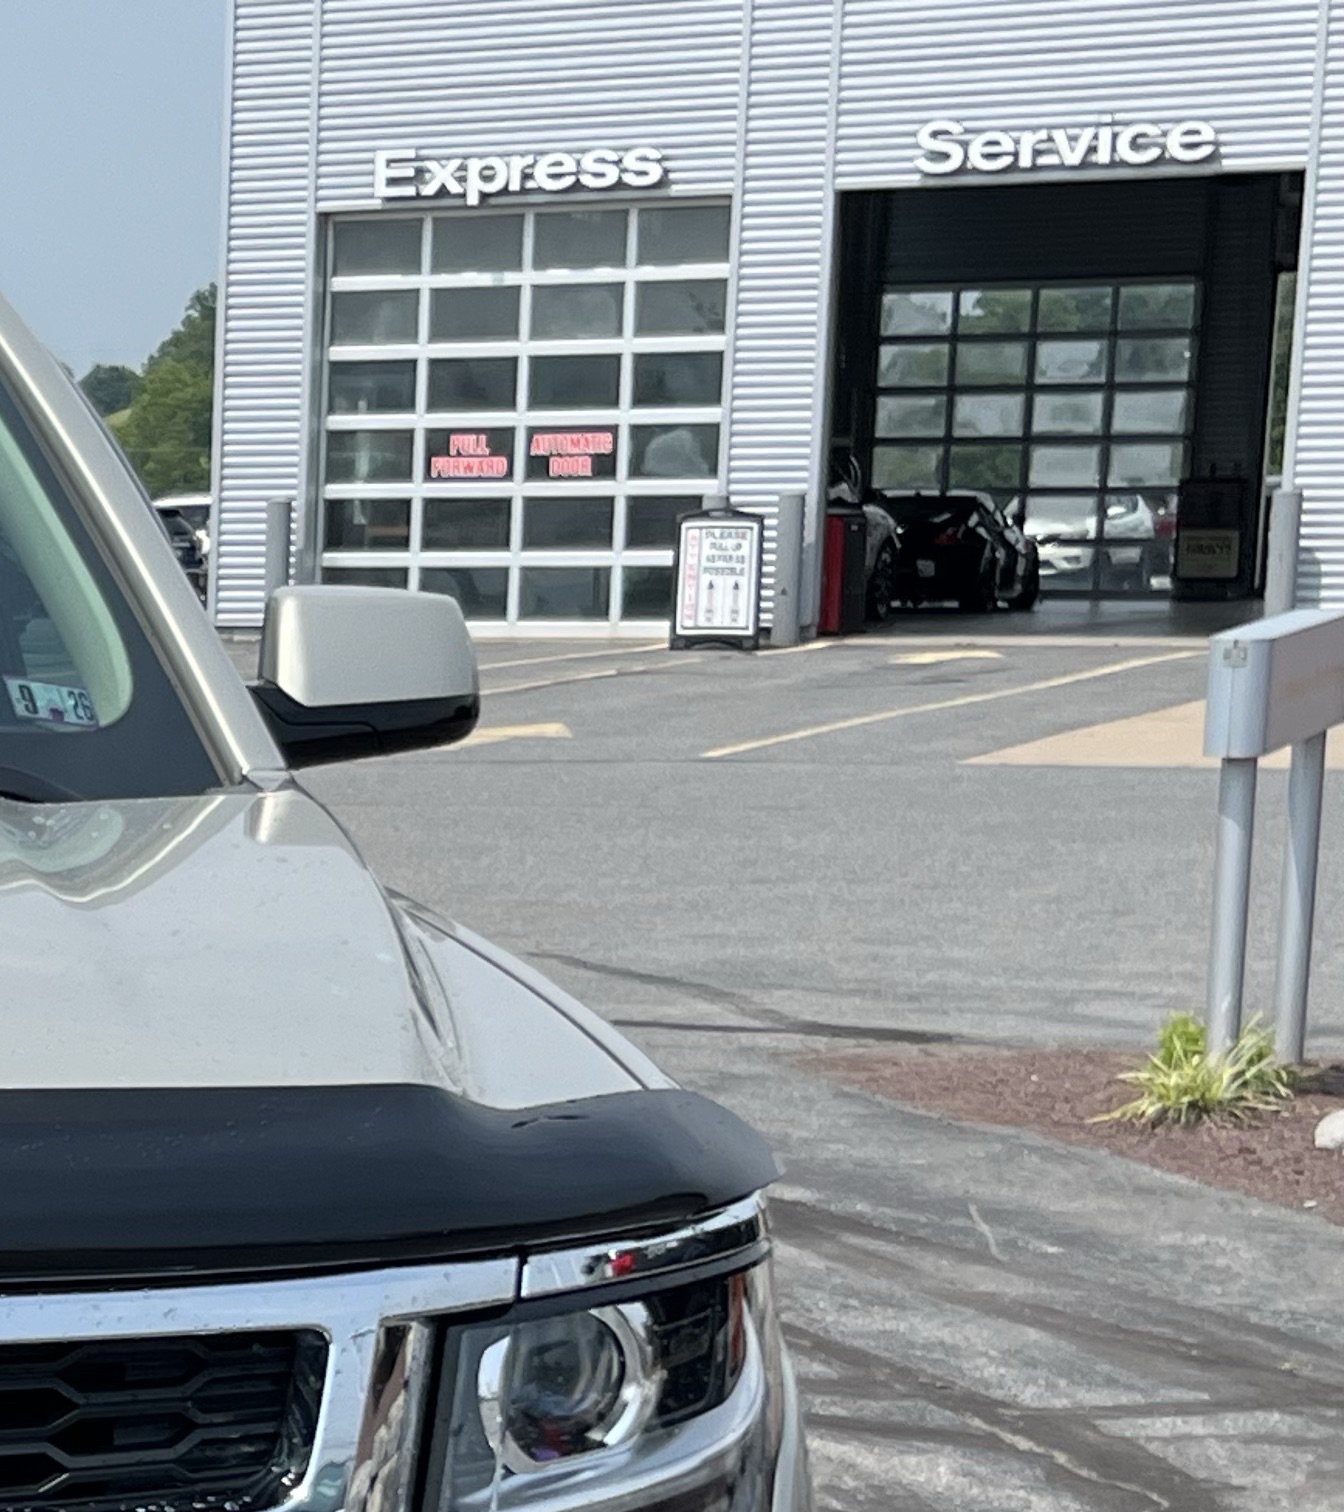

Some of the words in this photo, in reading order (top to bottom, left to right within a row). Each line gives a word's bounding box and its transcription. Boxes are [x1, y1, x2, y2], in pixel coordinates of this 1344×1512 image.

[913, 112, 1217, 175] Service
[373, 147, 664, 206] Express
[530, 432, 613, 456] AUTOMATIC
[431, 456, 508, 478] FORWARD
[549, 456, 592, 477] DOOR
